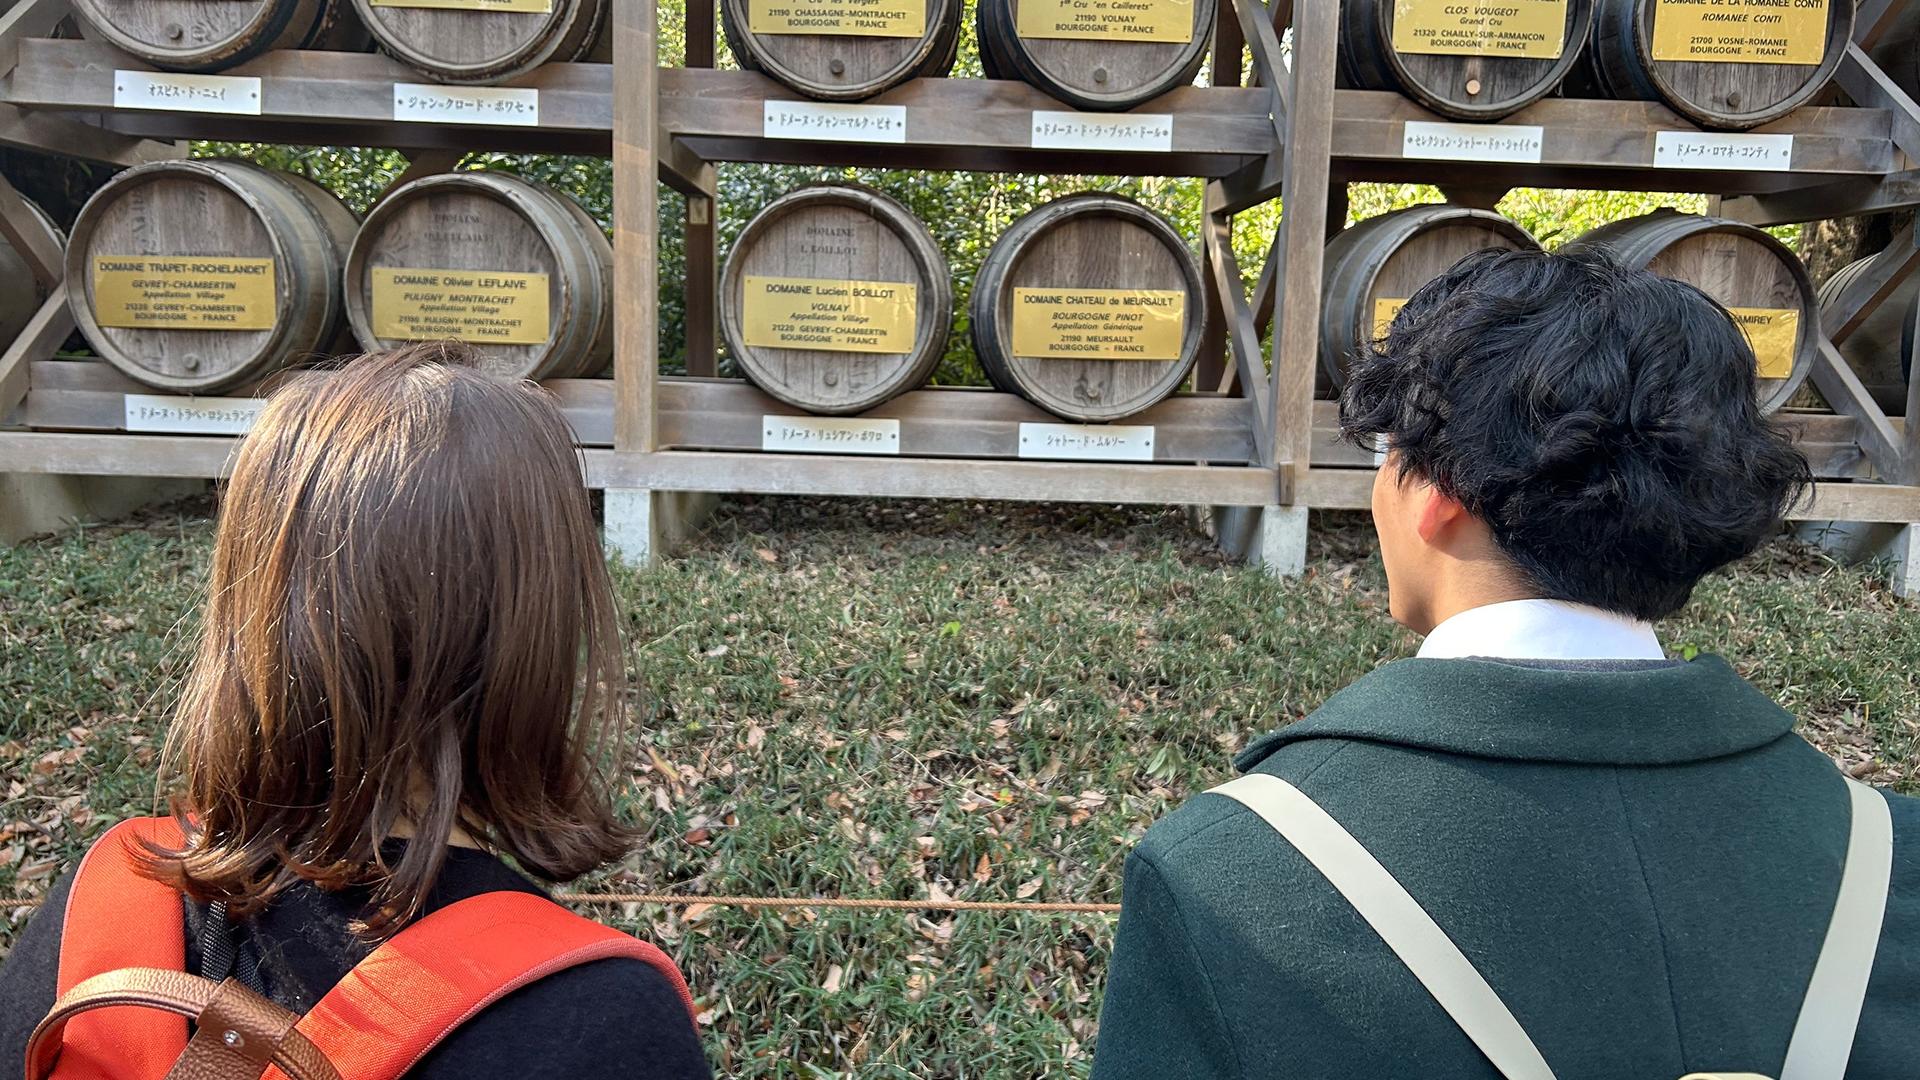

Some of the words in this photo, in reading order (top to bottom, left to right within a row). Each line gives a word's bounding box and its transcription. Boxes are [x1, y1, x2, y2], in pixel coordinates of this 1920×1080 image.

[1073, 0, 1088, 8] Cru
[1795, 0, 1822, 8] CONTI
[795, 9, 906, 19] CHASSAGNE-MONTRACHET
[1444, 6, 1468, 15] CLOS
[1474, 7, 1519, 16] VOUGEOT
[788, 18, 840, 26] BOURGOGNE
[855, 20, 887, 28] FRANCE
[1101, 15, 1136, 23] VOLNAY
[1460, 17, 1484, 25] Grand
[1488, 18, 1502, 26] Cru
[1702, 13, 1749, 22] ROMANEE
[1753, 15, 1782, 23] CONTI
[1055, 23, 1108, 32] BOURGOGNE
[1123, 25, 1154, 33] FRANCE
[1441, 29, 1545, 41] CHAILLY-SUR-ARMANCON
[1430, 39, 1482, 48] BOURGOGNE
[1496, 41, 1526, 50] FRANCE
[1718, 37, 1788, 46] VOSNE-ROMANEE
[1690, 46, 1742, 54] BOURGOGNE
[1756, 48, 1787, 56] FRANCE
[100, 262, 144, 272] DOMAINE
[150, 263, 267, 274] TRAPET-ROCHELANDET
[131, 280, 236, 289] GEVREY-CHAMBERTIN
[393, 275, 438, 286] DOMAINE
[443, 276, 474, 287] Olivier
[478, 278, 527, 289] LEFLAIVE
[143, 291, 191, 300] Appellation
[197, 291, 226, 300] Village
[766, 283, 812, 294] DOMAINE
[816, 286, 848, 297] Lucien
[852, 287, 895, 299] BOILLOT
[403, 292, 443, 302] PULIGNY
[449, 294, 517, 305] MONTRACHET
[1024, 294, 1062, 304] DOMAINE
[1065, 295, 1105, 305] CHATEAU
[1109, 296, 1120, 305] de
[1122, 296, 1173, 306] MEURSAULT
[153, 303, 245, 312] GEVREY-CHAMBERTIN
[418, 303, 467, 313] Appellation
[471, 305, 500, 315] Village
[811, 303, 850, 312] VOLNAY
[134, 312, 187, 321] BOURGOGNE
[202, 313, 236, 322] FRANCE
[424, 316, 522, 327] PULIGNY-MONTRACHET
[790, 312, 837, 322] Appellation
[842, 314, 870, 324] Village
[1052, 312, 1110, 321] BOURGOGNE
[1115, 312, 1145, 321] PINOT
[1735, 315, 1773, 324] AMIREY
[411, 325, 462, 334] BOURGOGNE
[477, 327, 511, 337] FRANCE
[772, 324, 795, 332] 21220
[799, 325, 887, 336] GEVREY-CHAMBERTIN
[1051, 322, 1098, 331] Appellation
[1103, 322, 1143, 332] Générique
[780, 333, 832, 343] BOURGOGNE
[847, 336, 878, 345] FRANCE
[1086, 335, 1134, 343] MEURSAULT
[1049, 343, 1100, 351] BOURGOGNE
[1113, 344, 1145, 352] FRANCE
